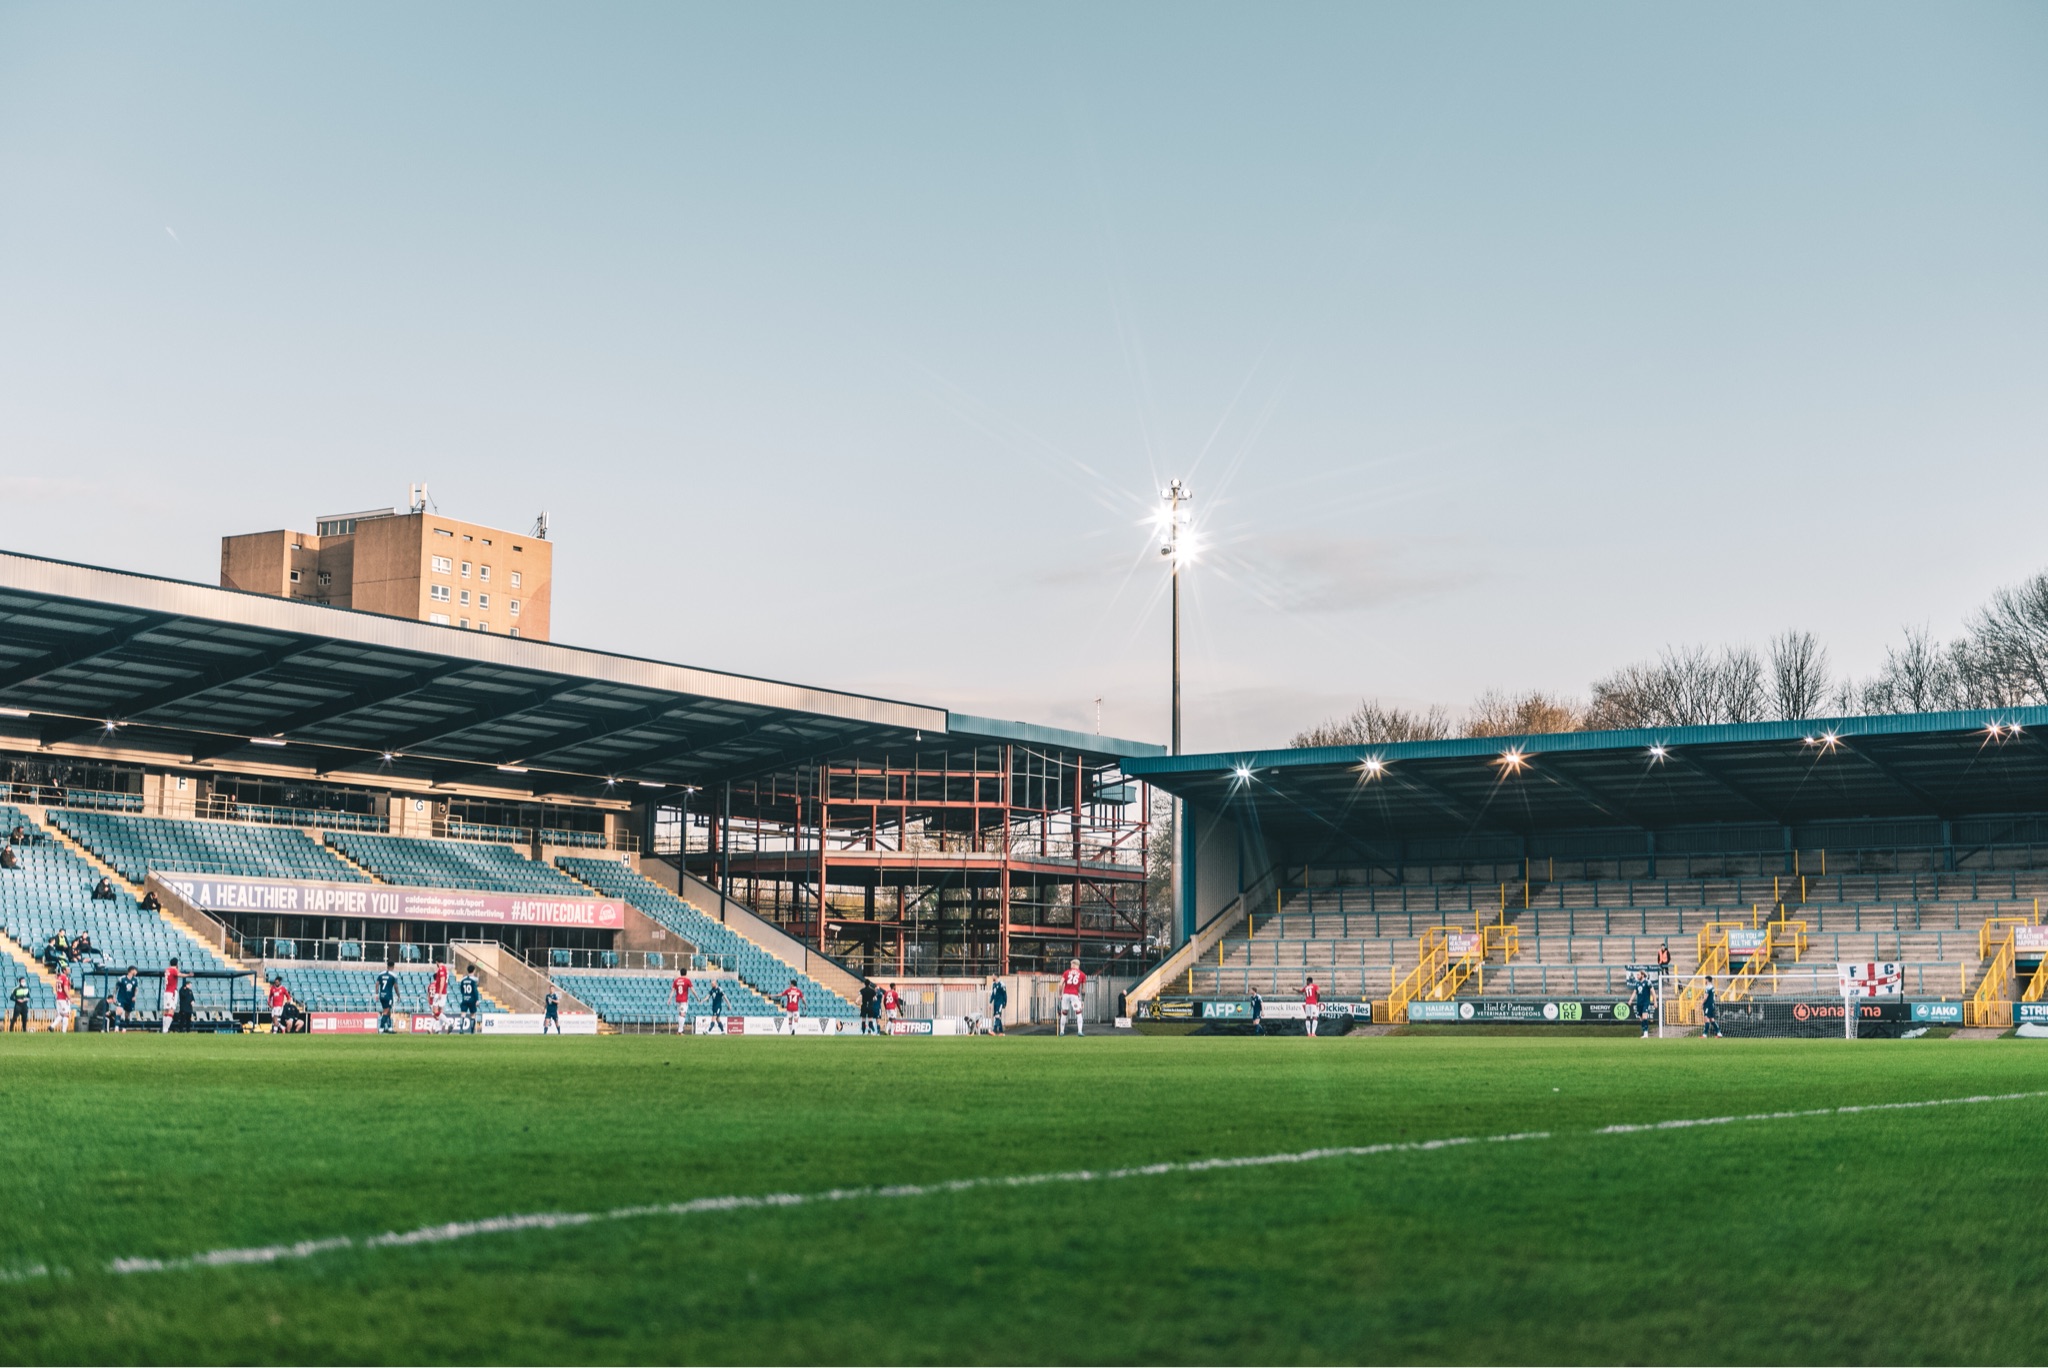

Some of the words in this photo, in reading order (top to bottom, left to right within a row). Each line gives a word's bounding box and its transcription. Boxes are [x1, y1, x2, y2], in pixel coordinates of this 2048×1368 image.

[179, 777, 186, 789] F
[416, 800, 424, 811] G
[622, 855, 630, 864] H
[200, 883, 211, 906] A
[216, 884, 298, 909] HEALTHIER
[304, 888, 366, 913] HAPPIER
[372, 892, 399, 914] YOU
[405, 896, 484, 908] calderdale.gov.uk/sport
[405, 905, 505, 919] calderdale.gov.uk/betterliving
[511, 901, 595, 924] #ACTIVECDALE
[1850, 966, 1856, 977] F
[1884, 963, 1894, 975] C
[382, 980, 388, 990] 7
[1067, 975, 1080, 985] 26
[463, 984, 472, 994] 10
[678, 985, 683, 995] 8
[1305, 988, 1313, 997] 11
[789, 995, 797, 1003] 14
[1203, 1003, 1236, 1017] AFP
[1319, 1003, 1349, 1012] Dickies
[1350, 1004, 1369, 1014] Tiles
[1500, 1003, 1506, 1011] &
[1507, 1003, 1534, 1011] Partners
[1562, 1003, 1577, 1011] CO
[1810, 1006, 1882, 1017] vanama
[1931, 1006, 1958, 1016] JAKO
[1563, 1011, 1576, 1019] RE
[895, 1022, 931, 1033] BETFRED
